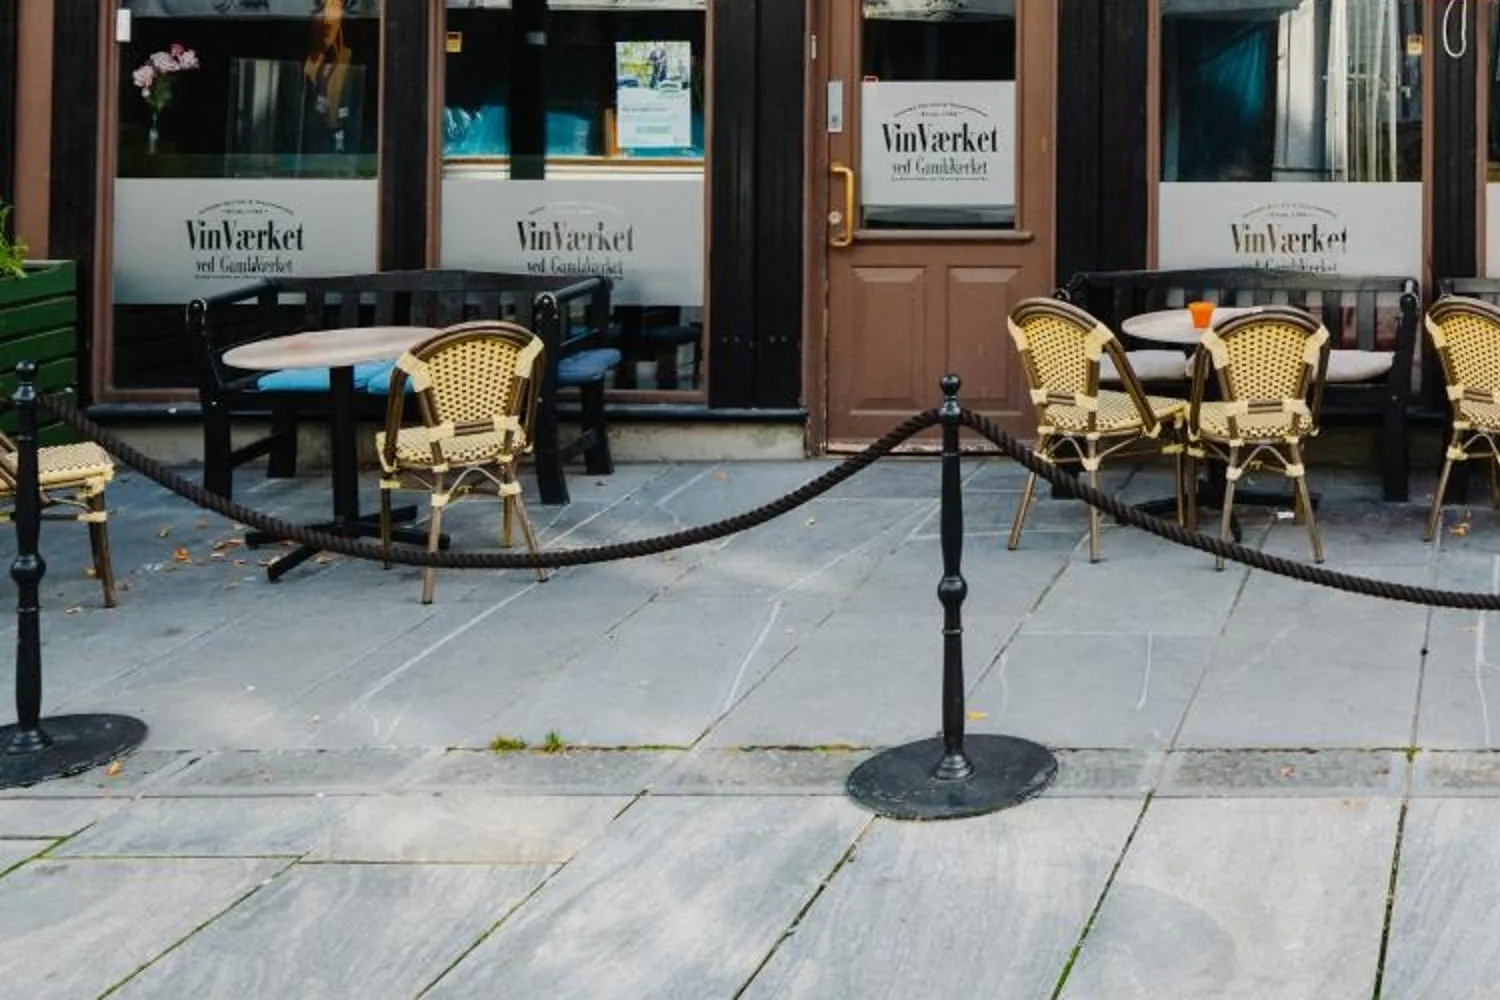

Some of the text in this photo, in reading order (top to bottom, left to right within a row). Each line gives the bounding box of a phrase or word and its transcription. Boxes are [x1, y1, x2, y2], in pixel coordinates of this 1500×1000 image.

[882, 122, 998, 152] VinVærket
[186, 219, 303, 250] VinVærket
[517, 220, 634, 251] VinVærket
[1231, 223, 1347, 253] VinVærket
